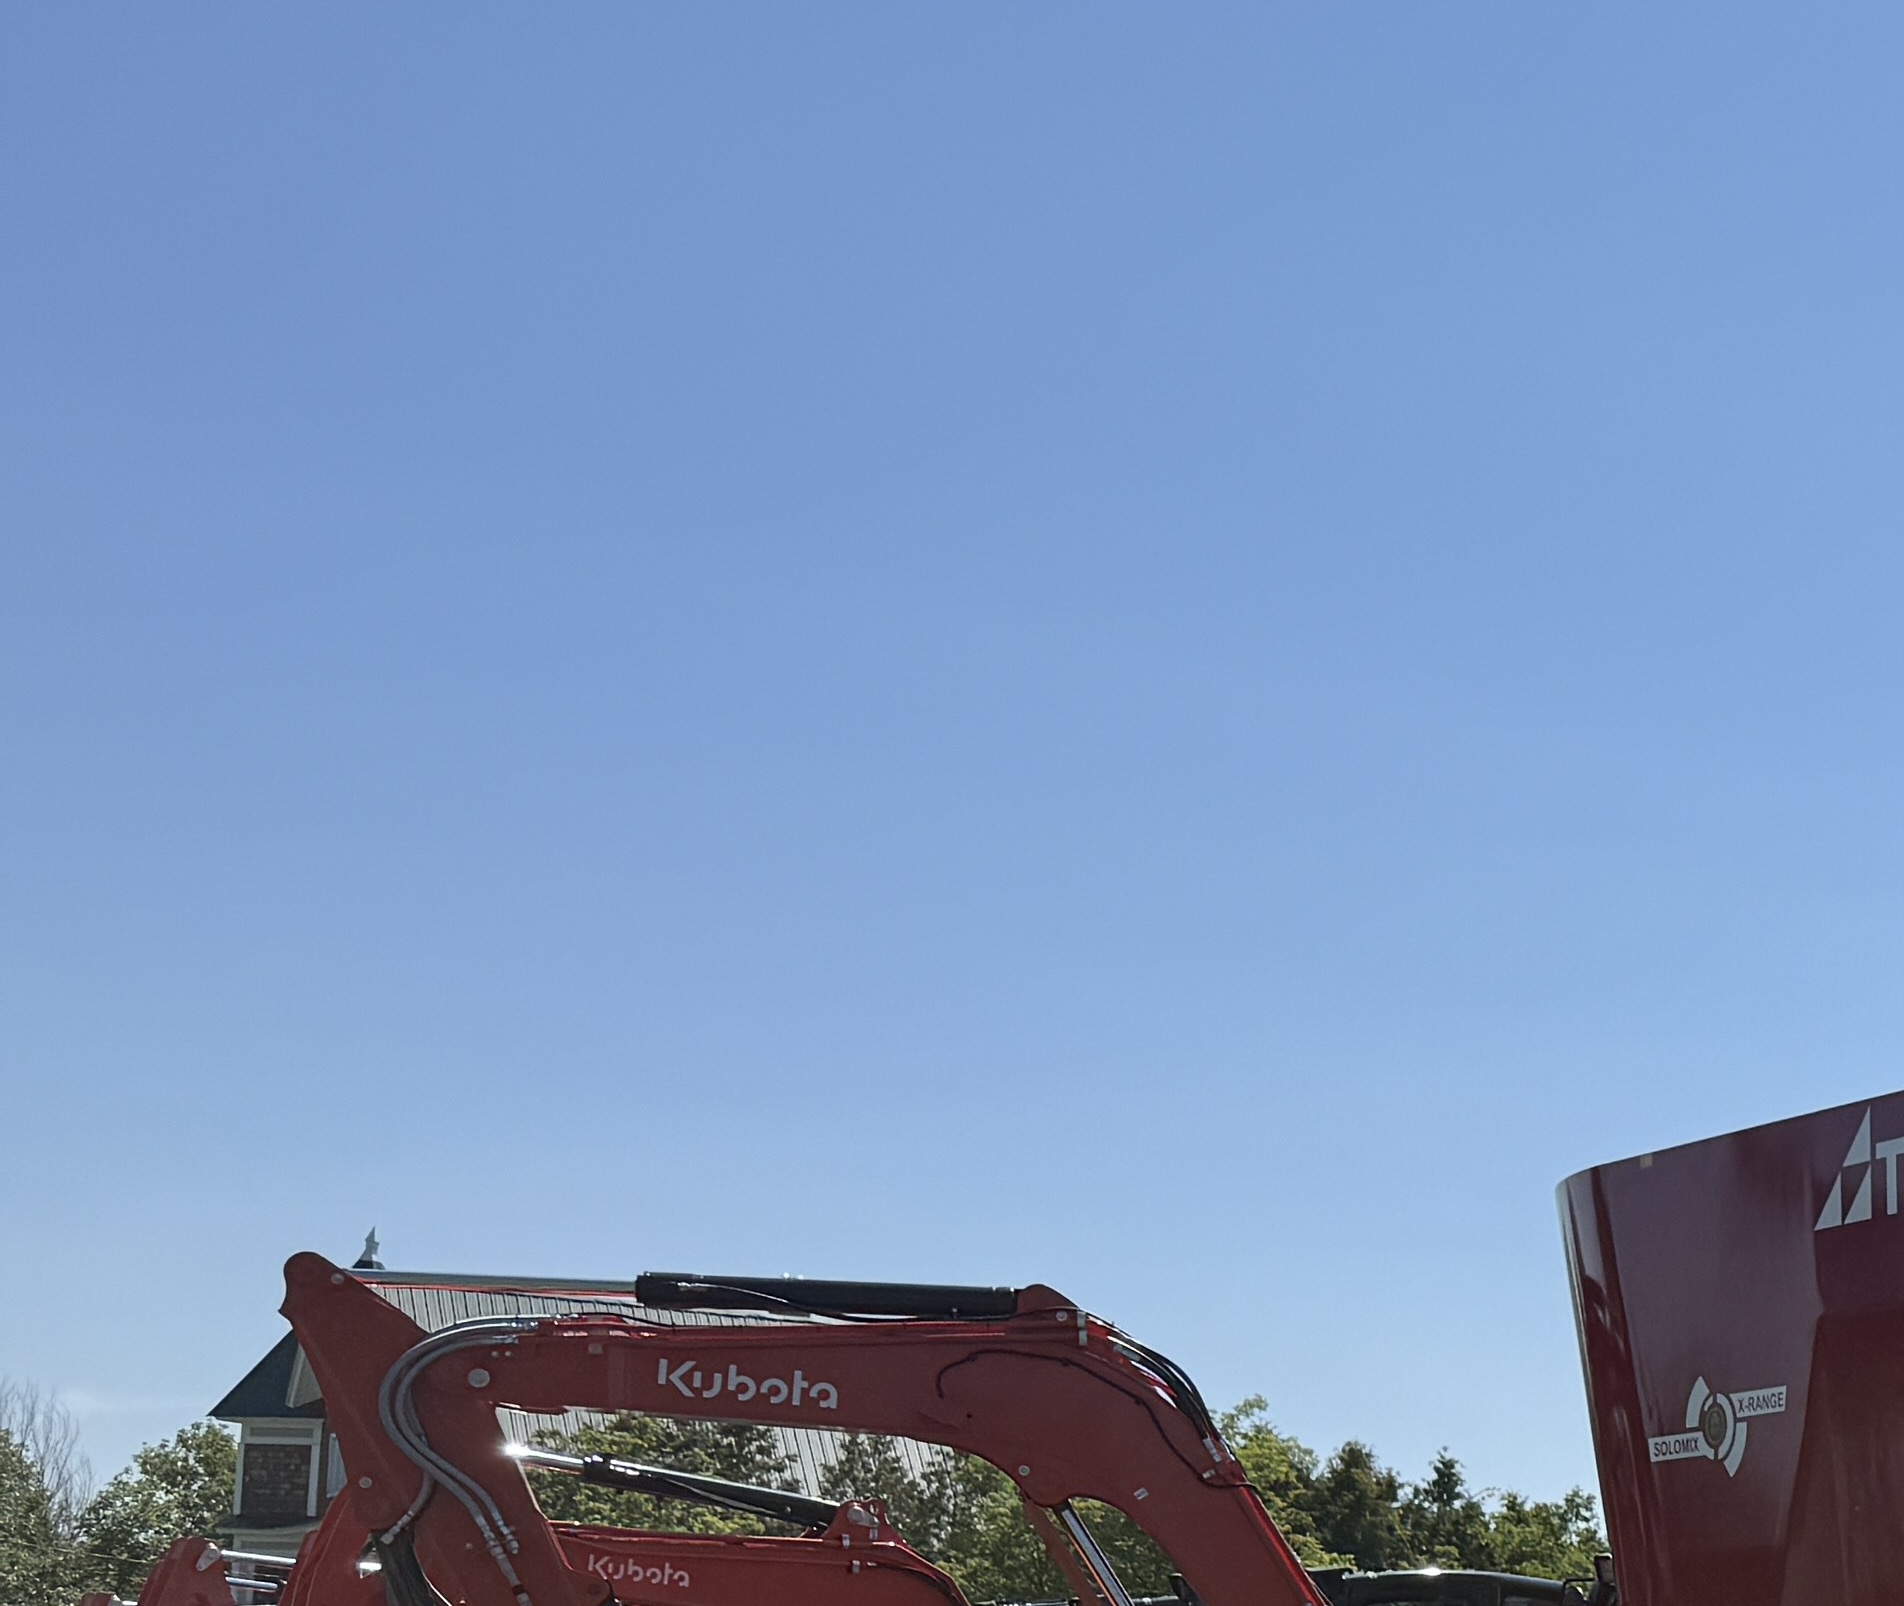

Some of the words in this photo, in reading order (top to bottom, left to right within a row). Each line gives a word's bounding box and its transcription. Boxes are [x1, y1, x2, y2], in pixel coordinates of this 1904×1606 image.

[657, 1358, 839, 1409] Kubota
[1737, 1391, 1785, 1413] X-RANGE
[1653, 1437, 1700, 1457] SOLOMIX
[587, 1553, 690, 1588] Kubota
